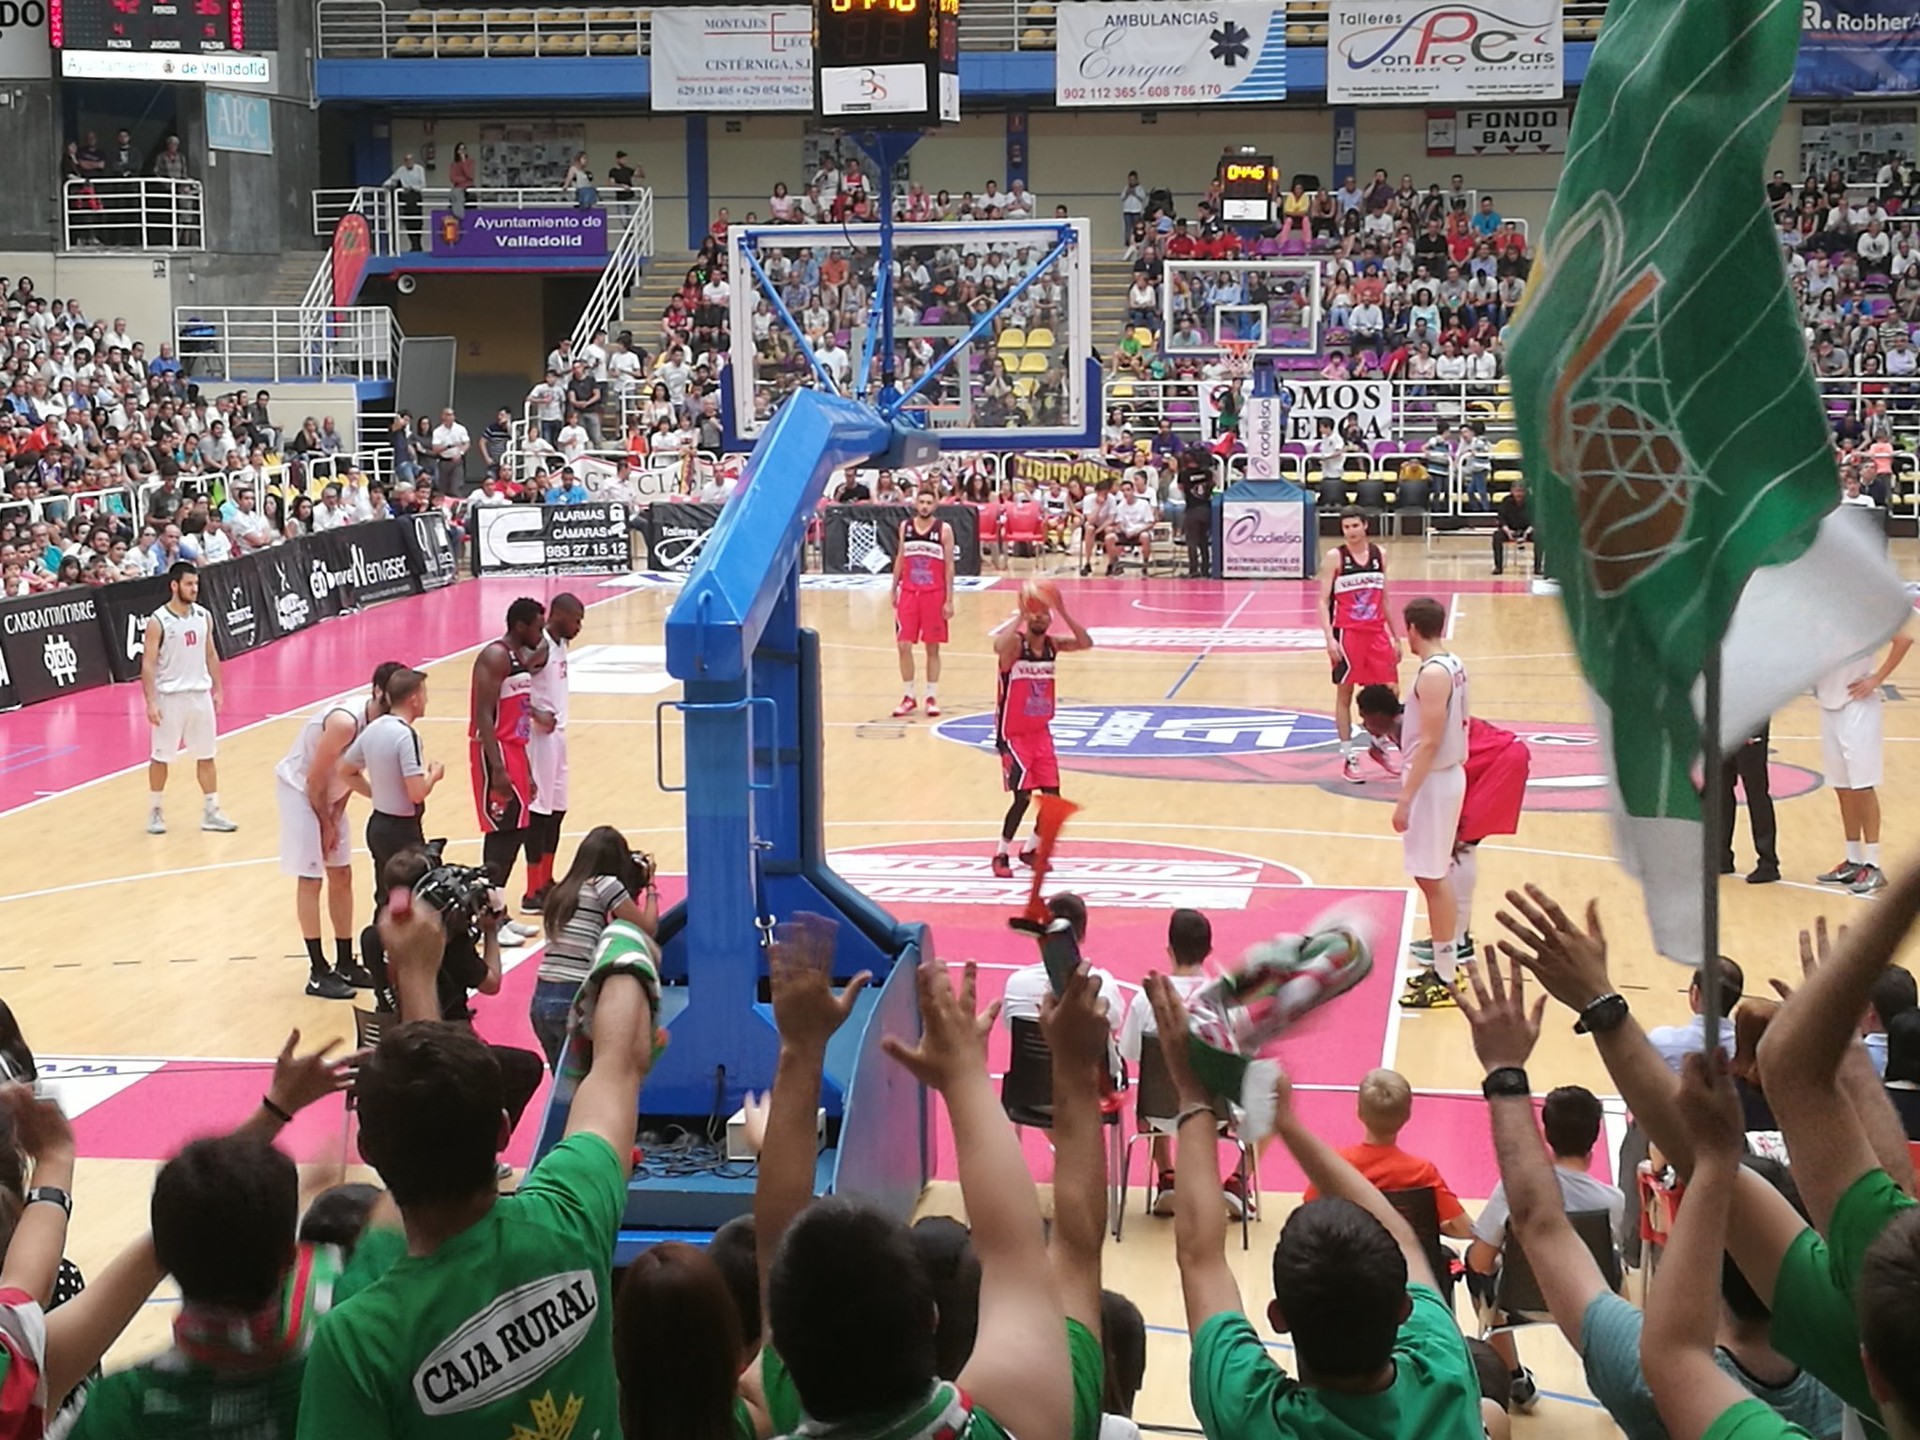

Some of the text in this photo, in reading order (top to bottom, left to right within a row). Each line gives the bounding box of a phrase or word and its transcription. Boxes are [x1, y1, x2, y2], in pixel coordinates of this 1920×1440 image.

[704, 18, 767, 29] MONTAJES
[1105, 11, 1219, 27] AMBULANCIAS
[1340, 13, 1403, 25] Talleres
[1079, 28, 1186, 89] Enrique
[182, 62, 197, 73] de
[203, 62, 266, 76] Valladolid
[1064, 88, 1086, 99] 902
[1091, 88, 1111, 99] 112
[1115, 87, 1137, 98] 365
[1148, 87, 1170, 98] 608
[1174, 86, 1196, 97] 786
[1201, 84, 1221, 95] 170
[217, 96, 259, 138] ABC
[1466, 111, 1558, 129] FONDO
[1483, 130, 1543, 144] BAJO
[474, 216, 601, 231] Ayuntamiento de
[495, 235, 582, 247] Valladolid
[552, 510, 605, 522] ALARMAS
[546, 542, 627, 557] 983 27 15 12
[184, 630, 197, 647] 10
[421, 1279, 596, 1404] CAJA RURAL
